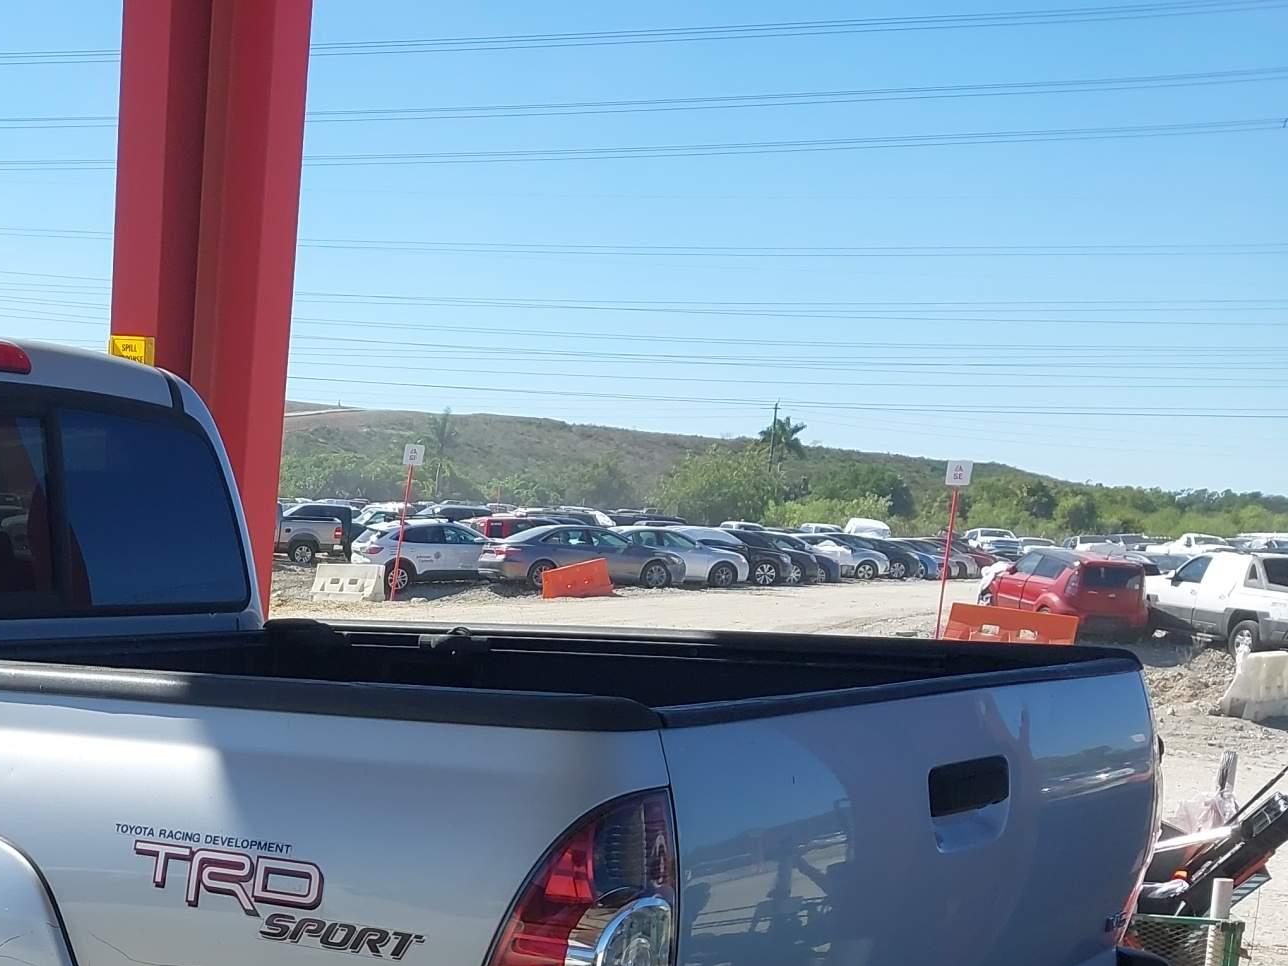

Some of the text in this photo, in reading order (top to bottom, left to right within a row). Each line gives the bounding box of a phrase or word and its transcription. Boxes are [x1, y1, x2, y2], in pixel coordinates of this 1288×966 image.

[122, 343, 138, 352] SPILL
[115, 823, 292, 855] TOYOTA RACING DEVELOPMENT
[133, 839, 325, 917] TRD
[259, 913, 425, 961] SPORT
